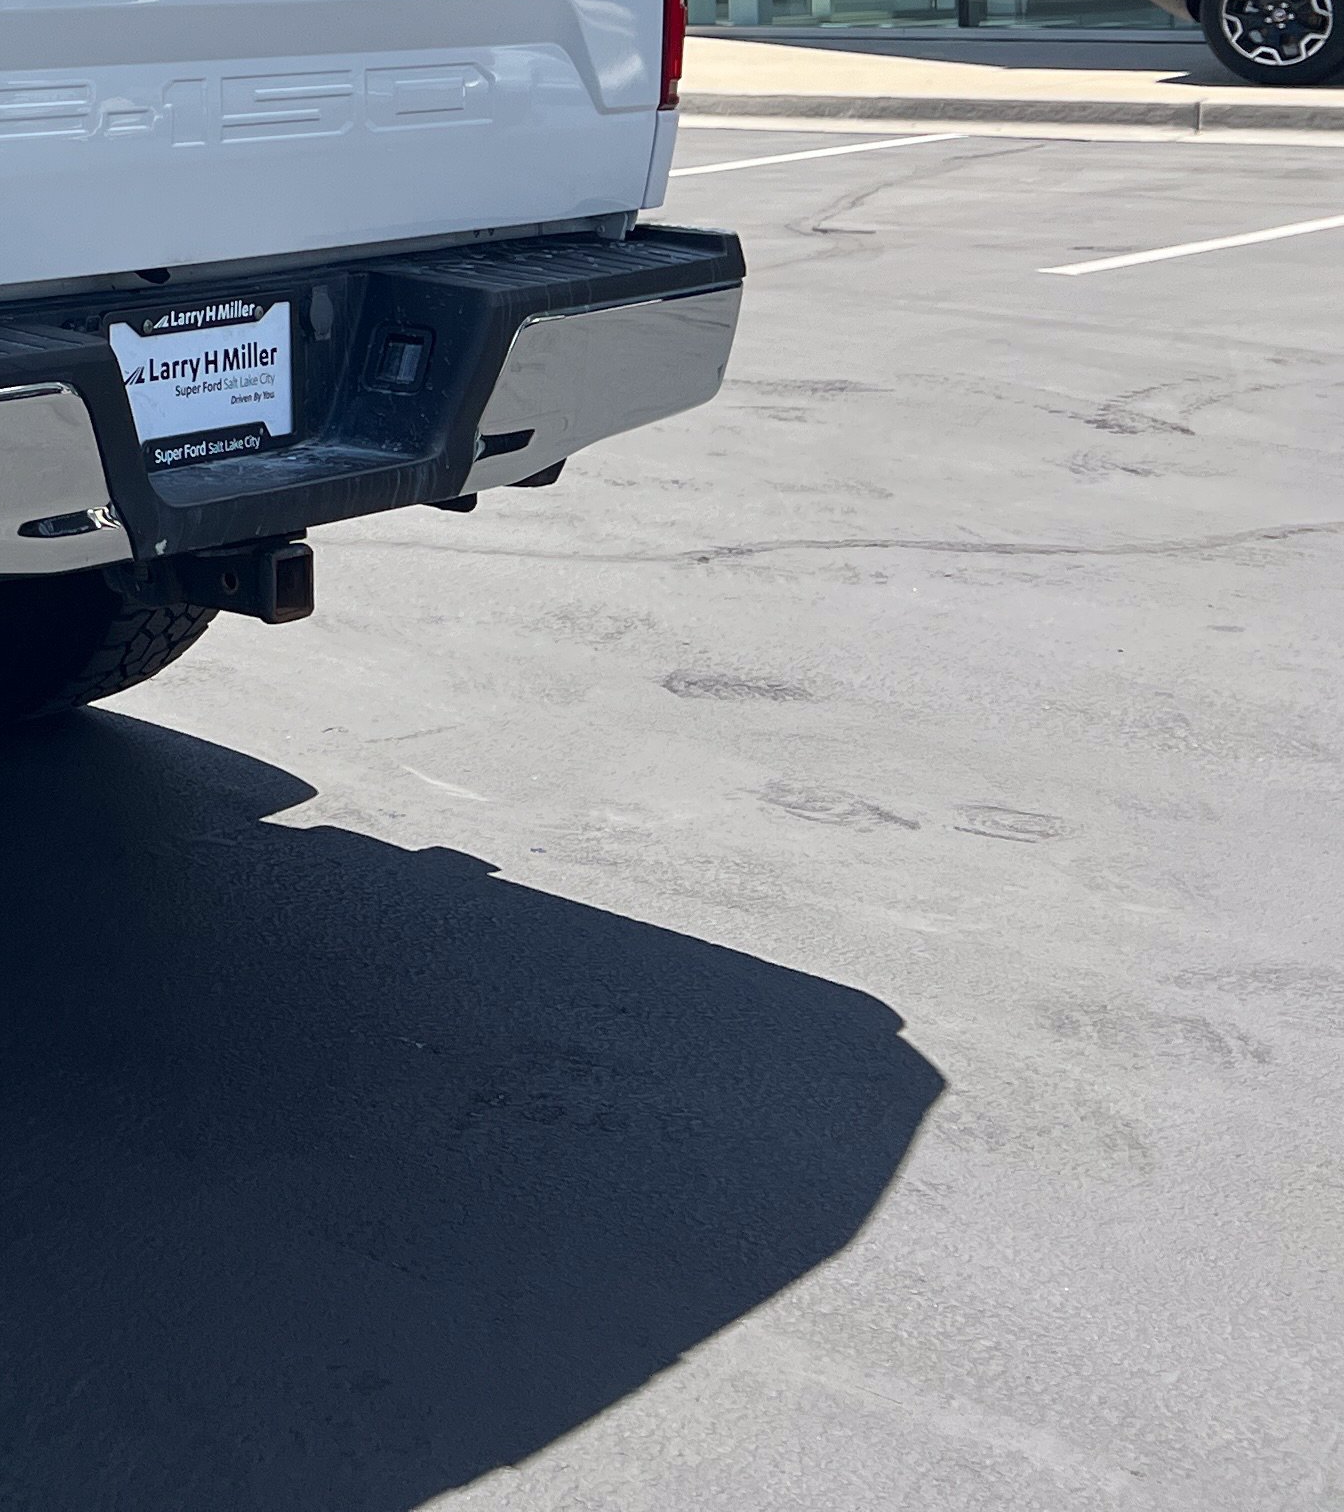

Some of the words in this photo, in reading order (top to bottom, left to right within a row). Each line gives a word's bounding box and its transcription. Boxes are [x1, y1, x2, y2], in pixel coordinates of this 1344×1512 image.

[170, 310, 204, 327] Larry
[205, 305, 217, 321] H
[217, 300, 255, 321] Miller
[149, 358, 200, 382] Larry
[204, 350, 218, 375] H
[222, 341, 277, 372] Miller
[175, 384, 201, 398] Super
[202, 378, 223, 393] Ford
[223, 376, 239, 391] Salt
[239, 375, 258, 389] Lake
[259, 372, 276, 386] City
[230, 393, 252, 405] Driven
[253, 391, 261, 403] By
[262, 390, 275, 400] You
[154, 448, 183, 466] Super
[184, 440, 207, 458] Ford
[208, 441, 224, 455] Salt
[224, 437, 243, 452] Lake
[244, 434, 261, 450] City
